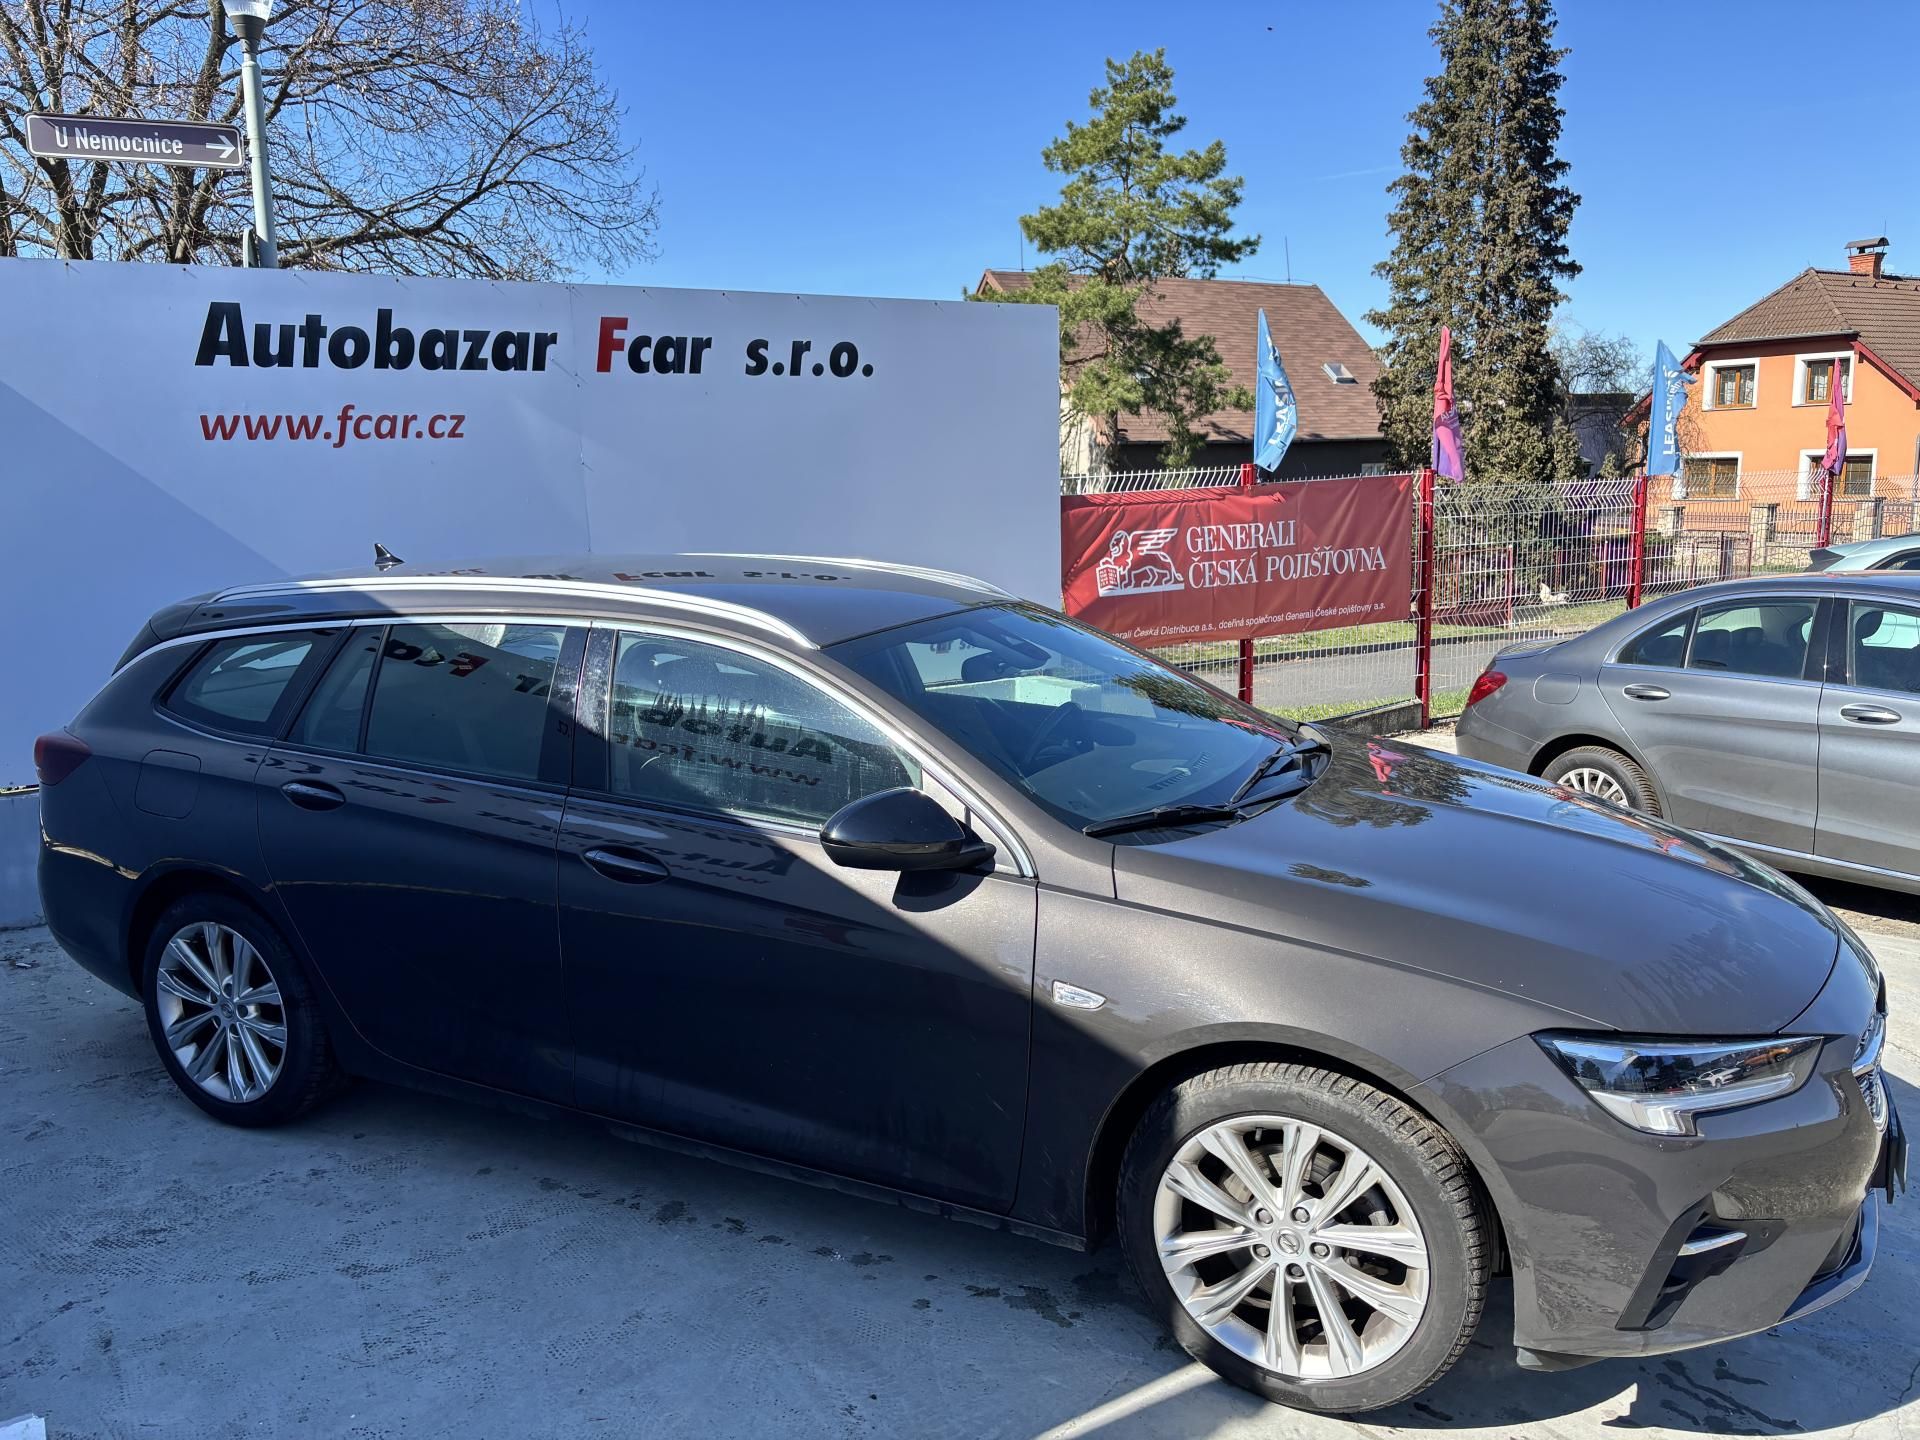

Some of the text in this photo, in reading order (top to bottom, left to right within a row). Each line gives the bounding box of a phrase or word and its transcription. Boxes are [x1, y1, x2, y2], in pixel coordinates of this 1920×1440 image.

[55, 125, 184, 155] U Nemocnice
[195, 301, 874, 378] Autobazar Fcar s.r.o.
[200, 405, 465, 449] www.fcar.cz
[1186, 520, 1296, 553] GENERALI
[1188, 545, 1388, 589] ČESKÁ POJIŠŤOVNA
[1133, 626, 1159, 638] Česká
[1160, 623, 1200, 636] Distribuce
[1218, 616, 1244, 630] dceřiná
[1245, 613, 1285, 627] společnost
[1285, 609, 1314, 622] Generali
[1314, 605, 1337, 617] České
[1338, 602, 1372, 616] pojišťovny
